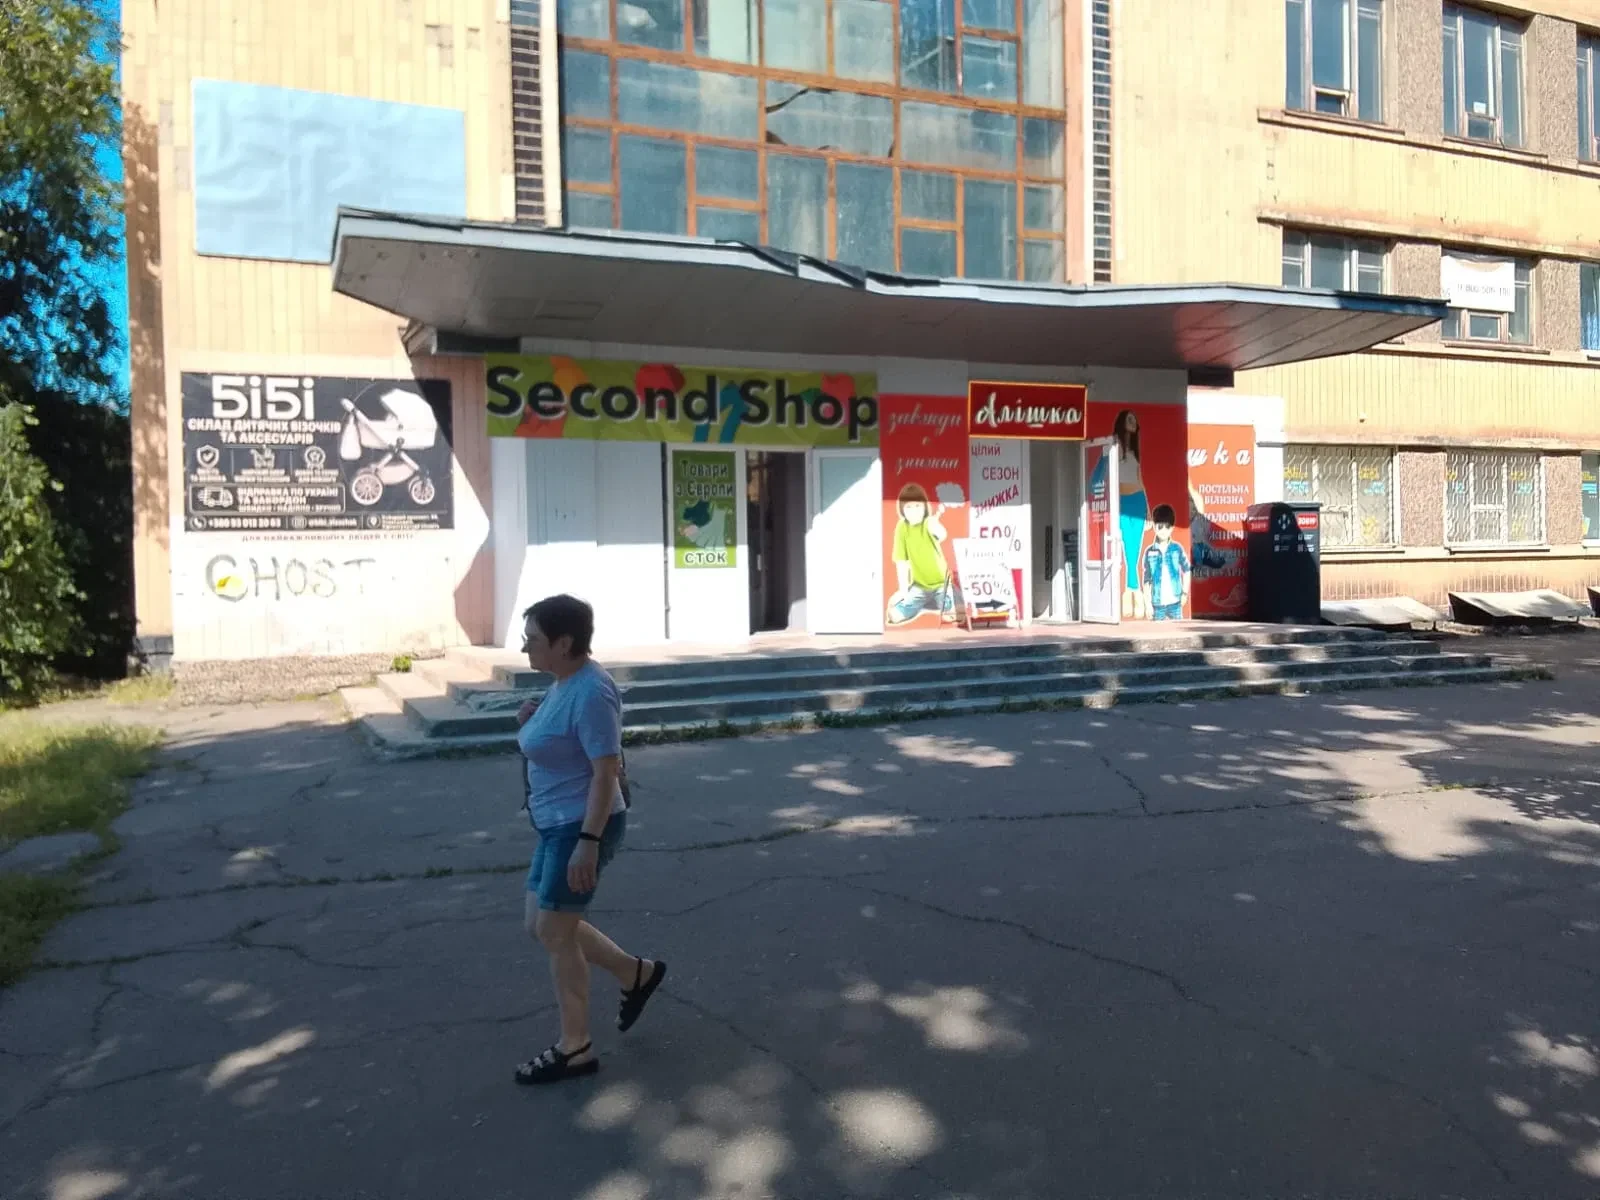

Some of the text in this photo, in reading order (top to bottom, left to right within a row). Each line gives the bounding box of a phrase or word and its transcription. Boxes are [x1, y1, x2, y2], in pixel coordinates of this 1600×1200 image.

[486, 365, 879, 442] Second Shop
[188, 418, 342, 433] СКЛАД ДИТЯЧИХ ВІЗОЧКІВ
[220, 432, 314, 444] ТА АКСЕСУАРІВ
[681, 460, 728, 477] Товари
[982, 467, 1019, 481] СЕЗОН
[237, 486, 338, 497] ВІДПРАВКА ПО УКРАЇНІ
[1199, 484, 1250, 494] ПОСТІЛЬНА
[973, 484, 1020, 519] ЗНИЖКА
[1204, 495, 1244, 505] БІЛИЗНА
[685, 552, 726, 564] СТОК
[964, 581, 1011, 596] -50%
